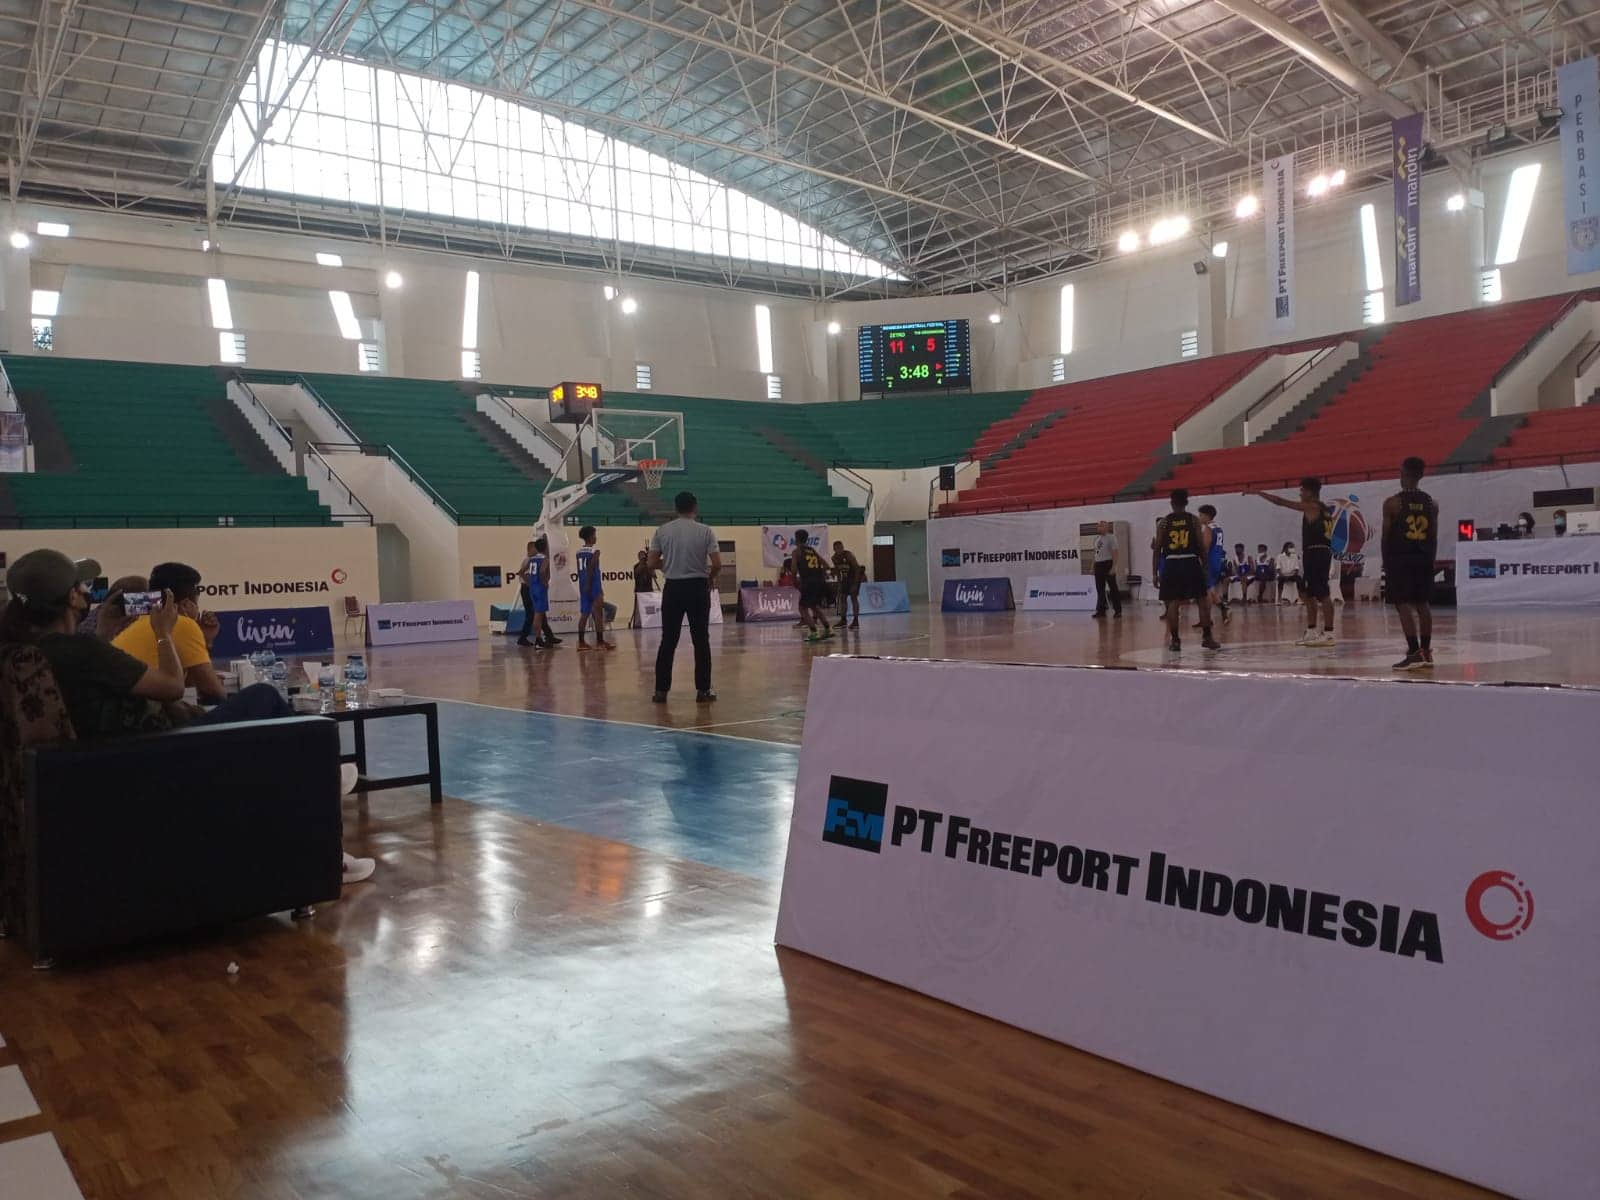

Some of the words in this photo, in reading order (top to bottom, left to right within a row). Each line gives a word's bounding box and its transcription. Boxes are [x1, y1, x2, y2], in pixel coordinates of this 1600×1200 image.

[1575, 94, 1587, 214] PERBASI
[1405, 147, 1418, 206] mandiri
[1405, 227, 1418, 287] mandiri
[1278, 278, 1288, 295] PT
[889, 340, 904, 353] 11
[927, 337, 936, 352] 5
[900, 364, 929, 379] 3:48
[1460, 523, 1472, 540] 4
[962, 552, 976, 563] PT
[977, 551, 1022, 563] FREEPORT
[1024, 549, 1078, 561] INDONESIA
[1500, 563, 1520, 575] PT
[1522, 562, 1591, 575] FREEPORT
[244, 581, 329, 595] INDONESIA
[891, 805, 943, 854] PT
[944, 814, 1140, 897] FREEPORT
[1145, 851, 1445, 964] INDONESIA
